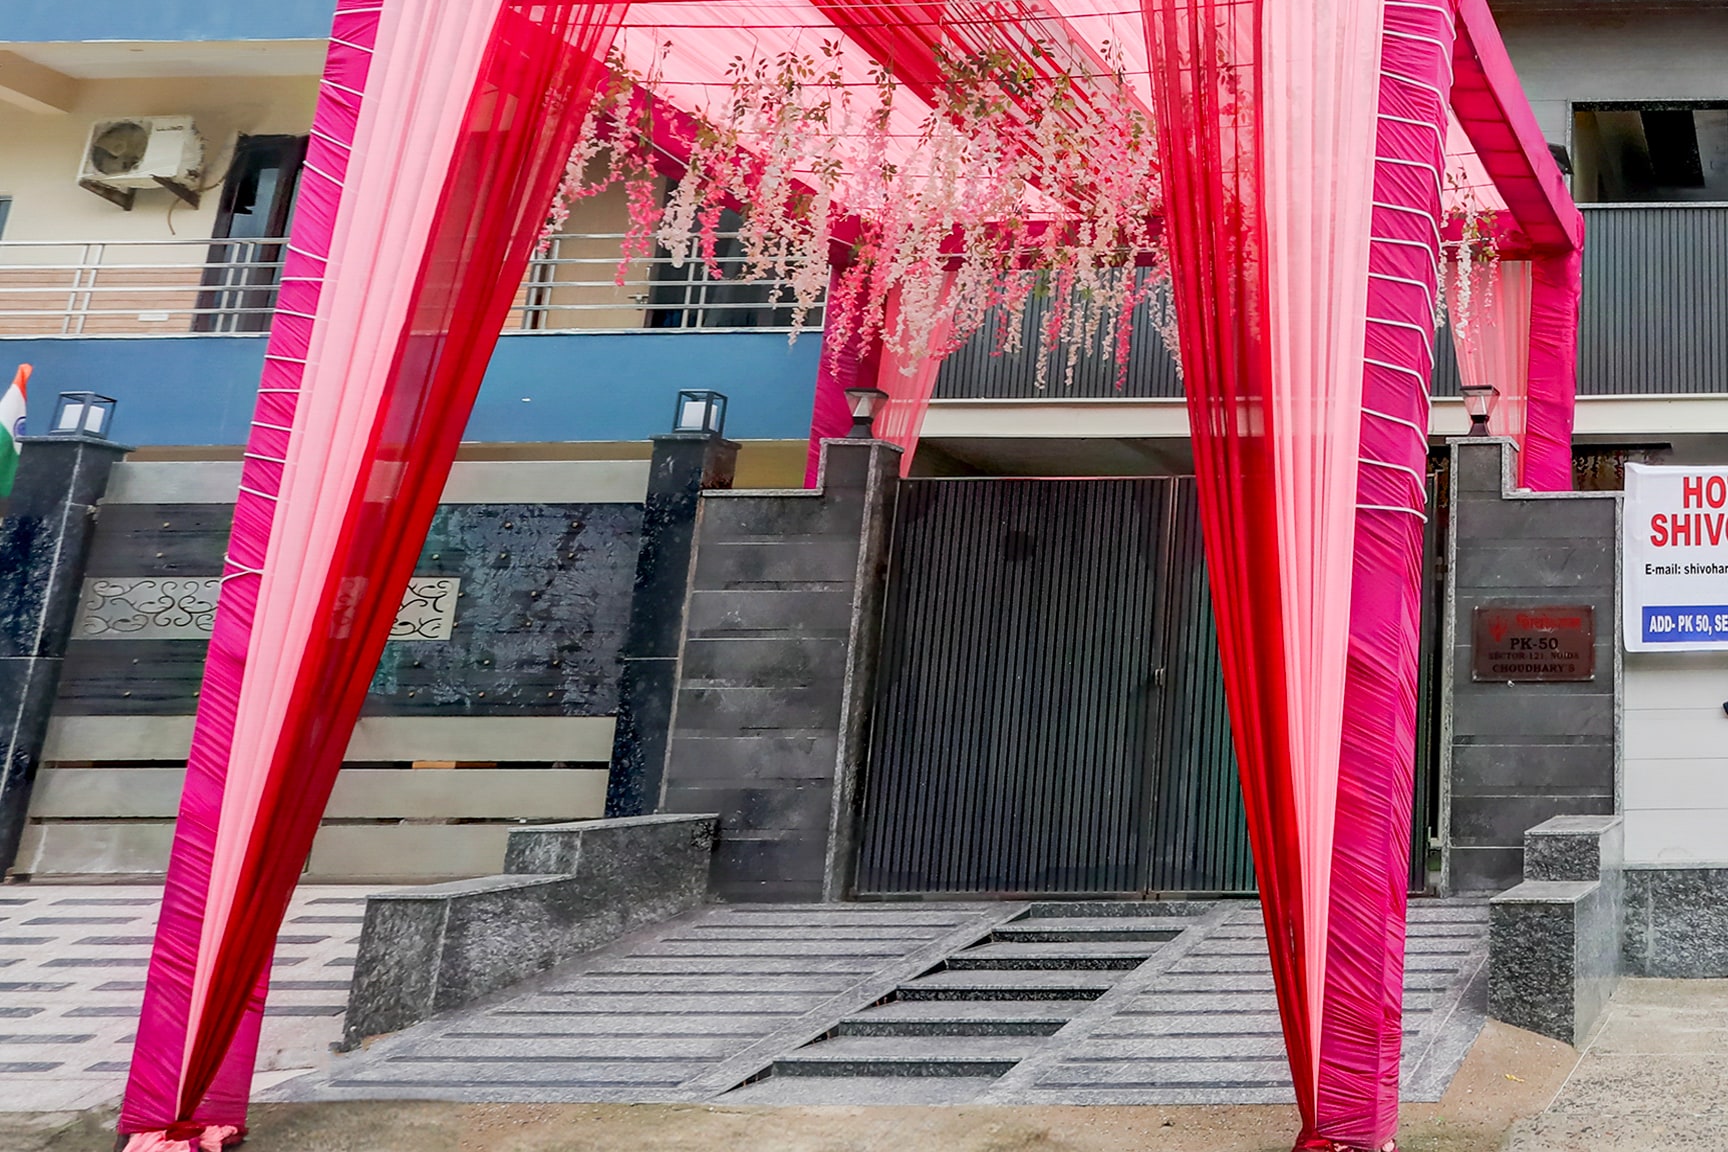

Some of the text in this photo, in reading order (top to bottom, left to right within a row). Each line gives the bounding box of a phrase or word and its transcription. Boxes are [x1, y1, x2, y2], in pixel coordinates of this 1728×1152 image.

[1645, 563, 1682, 575] E-mail:
[1649, 615, 1676, 632] ADD-
[1678, 615, 1694, 632] PK
[1696, 614, 1712, 635] 50,
[1510, 637, 1559, 650] PK-50
[1488, 651, 1526, 660] SECTOR
[1551, 651, 1580, 660] NOIDA
[1492, 663, 1576, 673] CHOUDHARY'S
